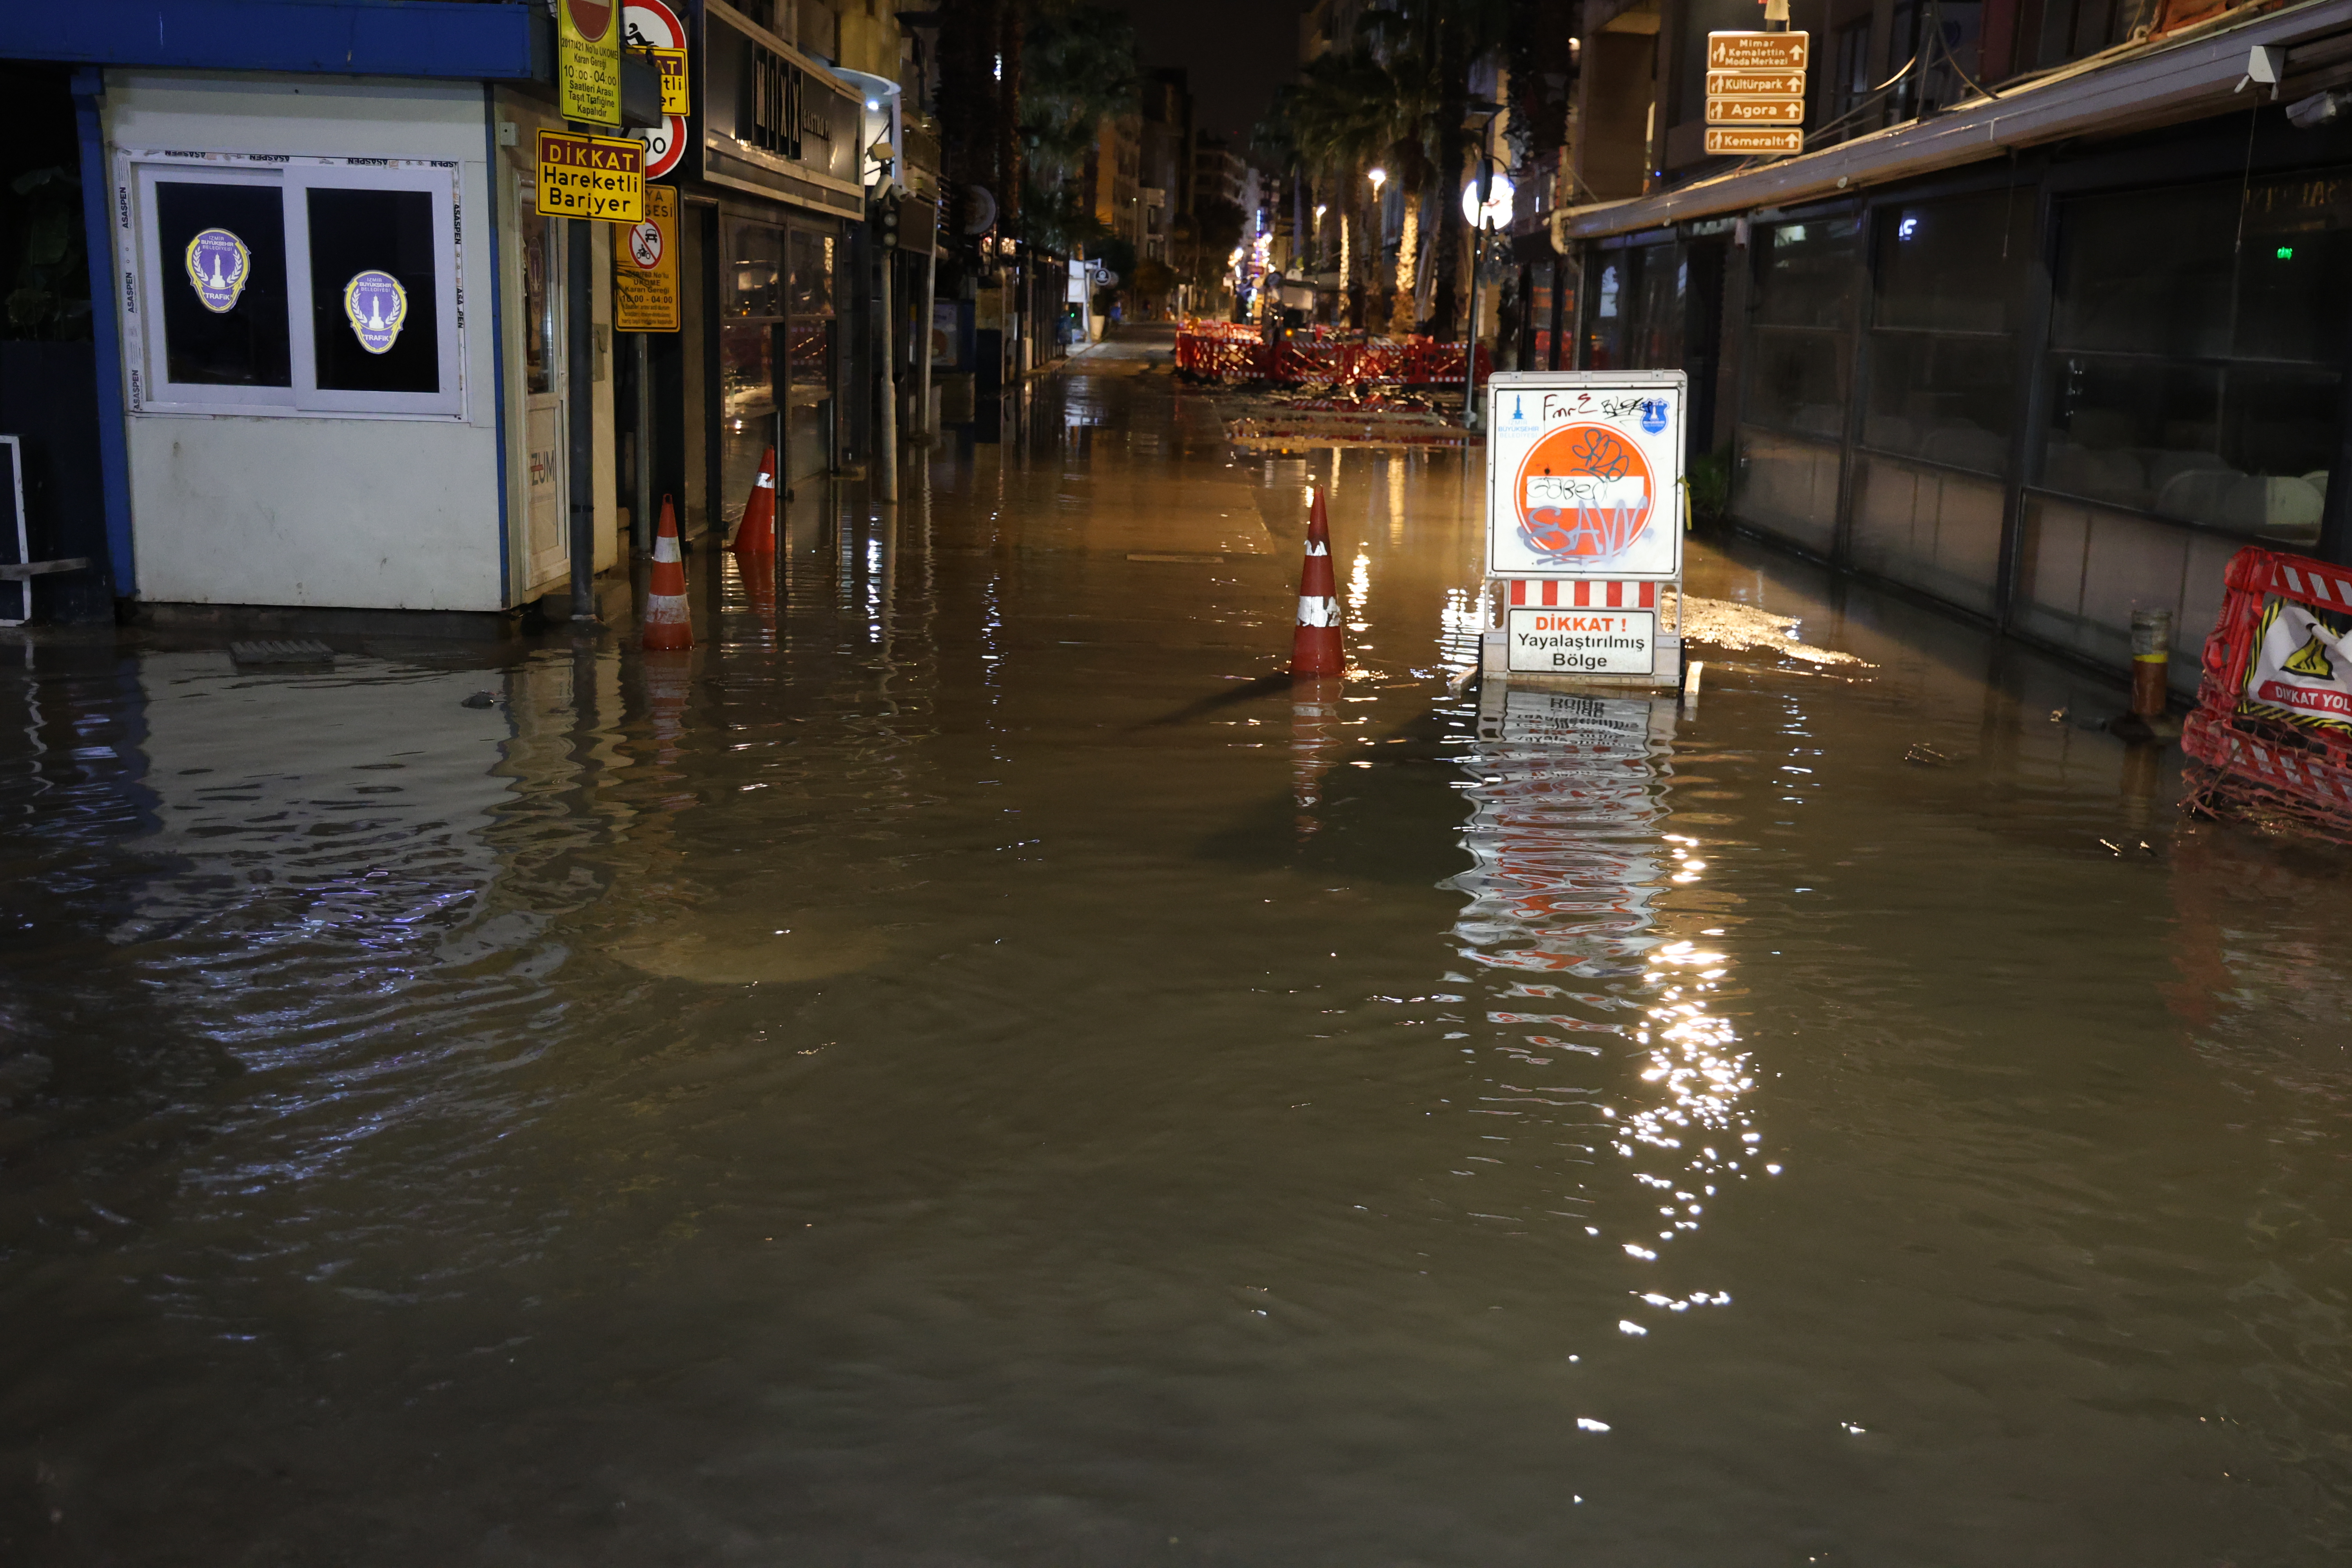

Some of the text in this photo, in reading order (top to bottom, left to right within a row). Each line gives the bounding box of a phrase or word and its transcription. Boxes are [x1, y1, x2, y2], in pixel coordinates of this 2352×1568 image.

[562, 38, 584, 51] 2017/421
[570, 80, 613, 96] Saatleri Arası
[1725, 79, 1783, 92] Kültürpark
[568, 90, 584, 103] Taşıt
[577, 104, 606, 117] Kapalıdır
[1731, 104, 1777, 118] Agora
[1725, 136, 1784, 146] Kemeraltı
[550, 142, 634, 171] DİKKAT
[544, 165, 637, 193] Hareketli
[120, 187, 128, 229] ASASPEN
[550, 187, 631, 215] Bariyer
[126, 273, 134, 313] ASASPEN
[1536, 613, 1626, 632] DİKKAT !
[1518, 633, 1645, 652] Yayalaştırılmış
[1553, 653, 1607, 669] Bölge
[2322, 694, 2351, 712] YOL
